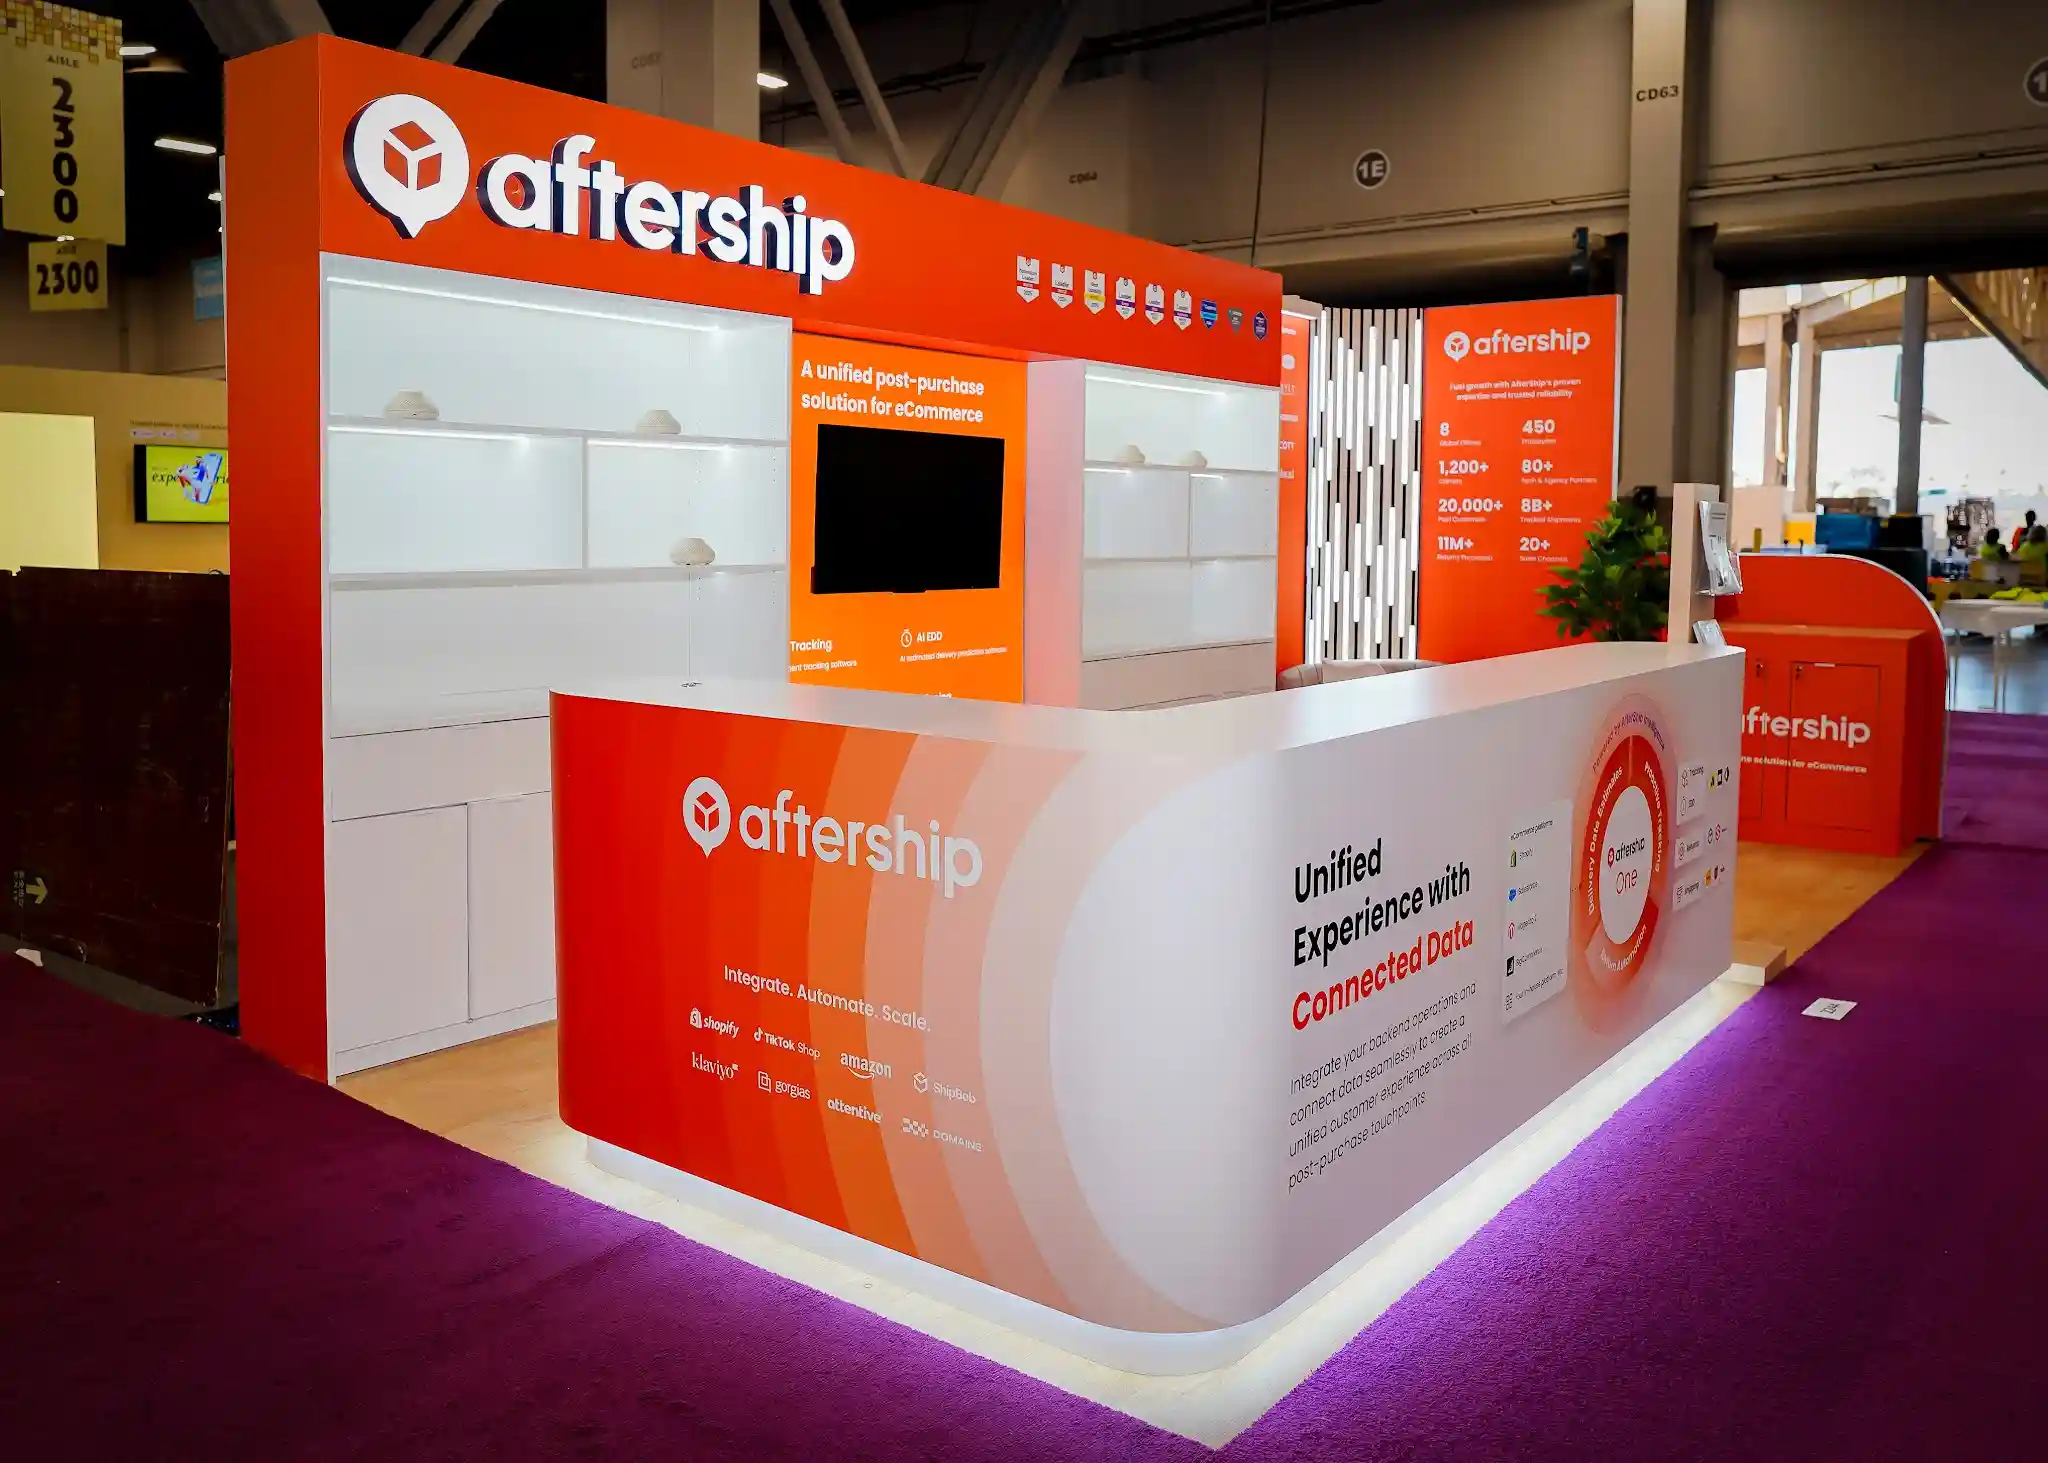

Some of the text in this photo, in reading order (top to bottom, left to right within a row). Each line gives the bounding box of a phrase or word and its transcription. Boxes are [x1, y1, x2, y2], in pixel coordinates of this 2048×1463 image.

[1636, 85, 1679, 102] CD63
[1358, 160, 1385, 179] 1E
[477, 134, 856, 296] aftership
[36, 260, 99, 295] 2300
[1474, 327, 1591, 356] aftership
[801, 359, 985, 396] A unified post-purchase
[1493, 379, 1510, 389] with
[1553, 377, 1582, 388] proven
[801, 391, 984, 423] solution for eCommerce
[1491, 392, 1507, 401] and
[1508, 390, 1536, 400] trusted
[1439, 422, 1450, 437] 8
[1522, 419, 1556, 434] 450
[1438, 459, 1489, 476] 1,200+
[1521, 458, 1553, 474] 80+
[1438, 498, 1503, 515] 20,000+
[1521, 498, 1553, 513] 8B+
[1437, 535, 1474, 550] 11M+
[1519, 536, 1550, 551] 20+
[790, 638, 833, 653] Tracking
[916, 630, 943, 643] AI EDD
[803, 661, 830, 672] tracking
[830, 659, 857, 669] software
[1740, 755, 1868, 774] ne solution for eCommerce
[738, 789, 983, 899] aftership
[1588, 766, 1623, 915] Delivery Date Estimates
[1615, 837, 1645, 862] aftership
[1294, 837, 1382, 903] Unified
[1616, 868, 1638, 895] One
[1293, 861, 1470, 968] Experience with
[1292, 919, 1474, 1031] Connected Data
[724, 964, 932, 1032] Integrate. Automate. Scale.
[703, 1015, 740, 1039] shopify
[1289, 980, 1477, 1095] Integrate your backend operations and
[764, 1032, 821, 1061] TikTok Shop
[691, 1051, 735, 1081] klaviyo
[840, 1052, 892, 1079] amazon
[1289, 1013, 1466, 1127] connect data seamlessly to create a
[774, 1079, 811, 1100] gorgias
[932, 1081, 977, 1104] ShipBob
[1289, 1032, 1473, 1158] unified customer experience across all
[827, 1097, 883, 1124] attentive
[933, 1129, 983, 1152] DOMAINE
[1288, 1127, 1369, 1194] post-purchase
